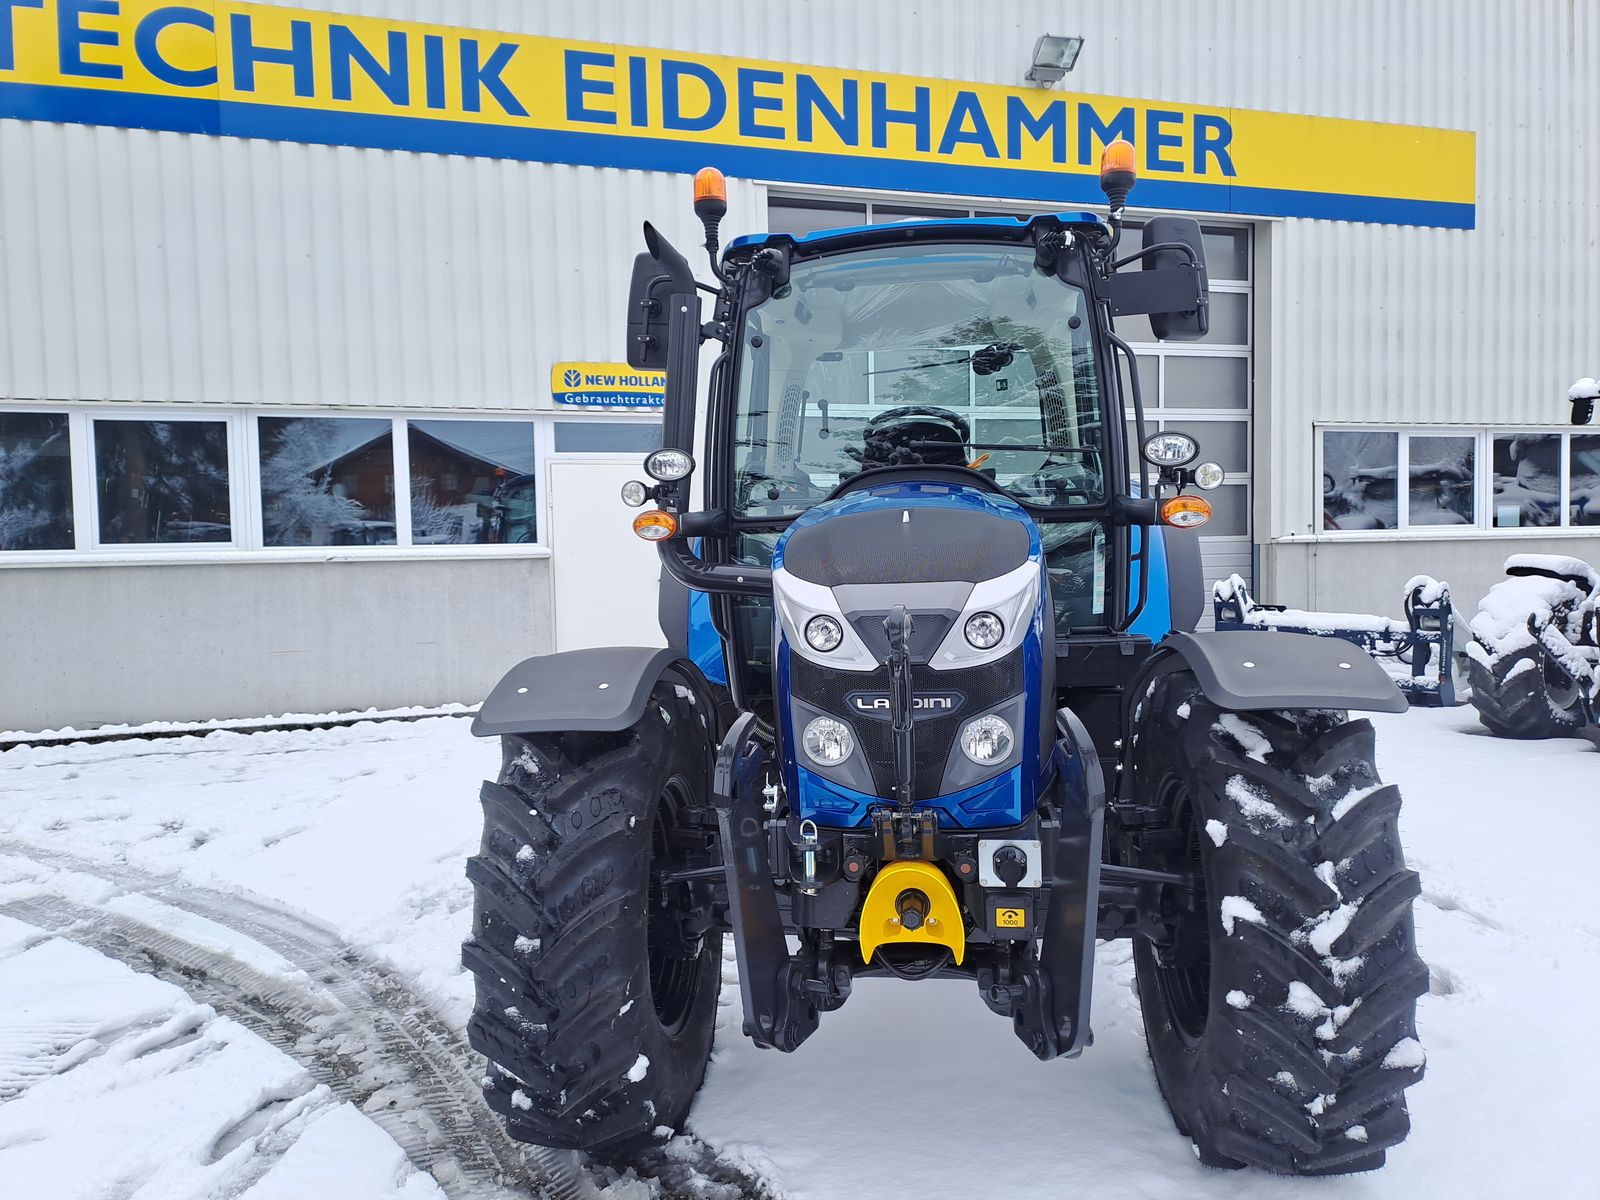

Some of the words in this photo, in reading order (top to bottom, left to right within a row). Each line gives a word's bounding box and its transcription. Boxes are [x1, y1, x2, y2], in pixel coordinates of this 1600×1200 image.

[0, 0, 530, 117] TECHNIK
[564, 49, 1237, 177] EIDENHAMMER
[585, 375, 615, 386] NEW
[856, 697, 952, 709] LADINI
